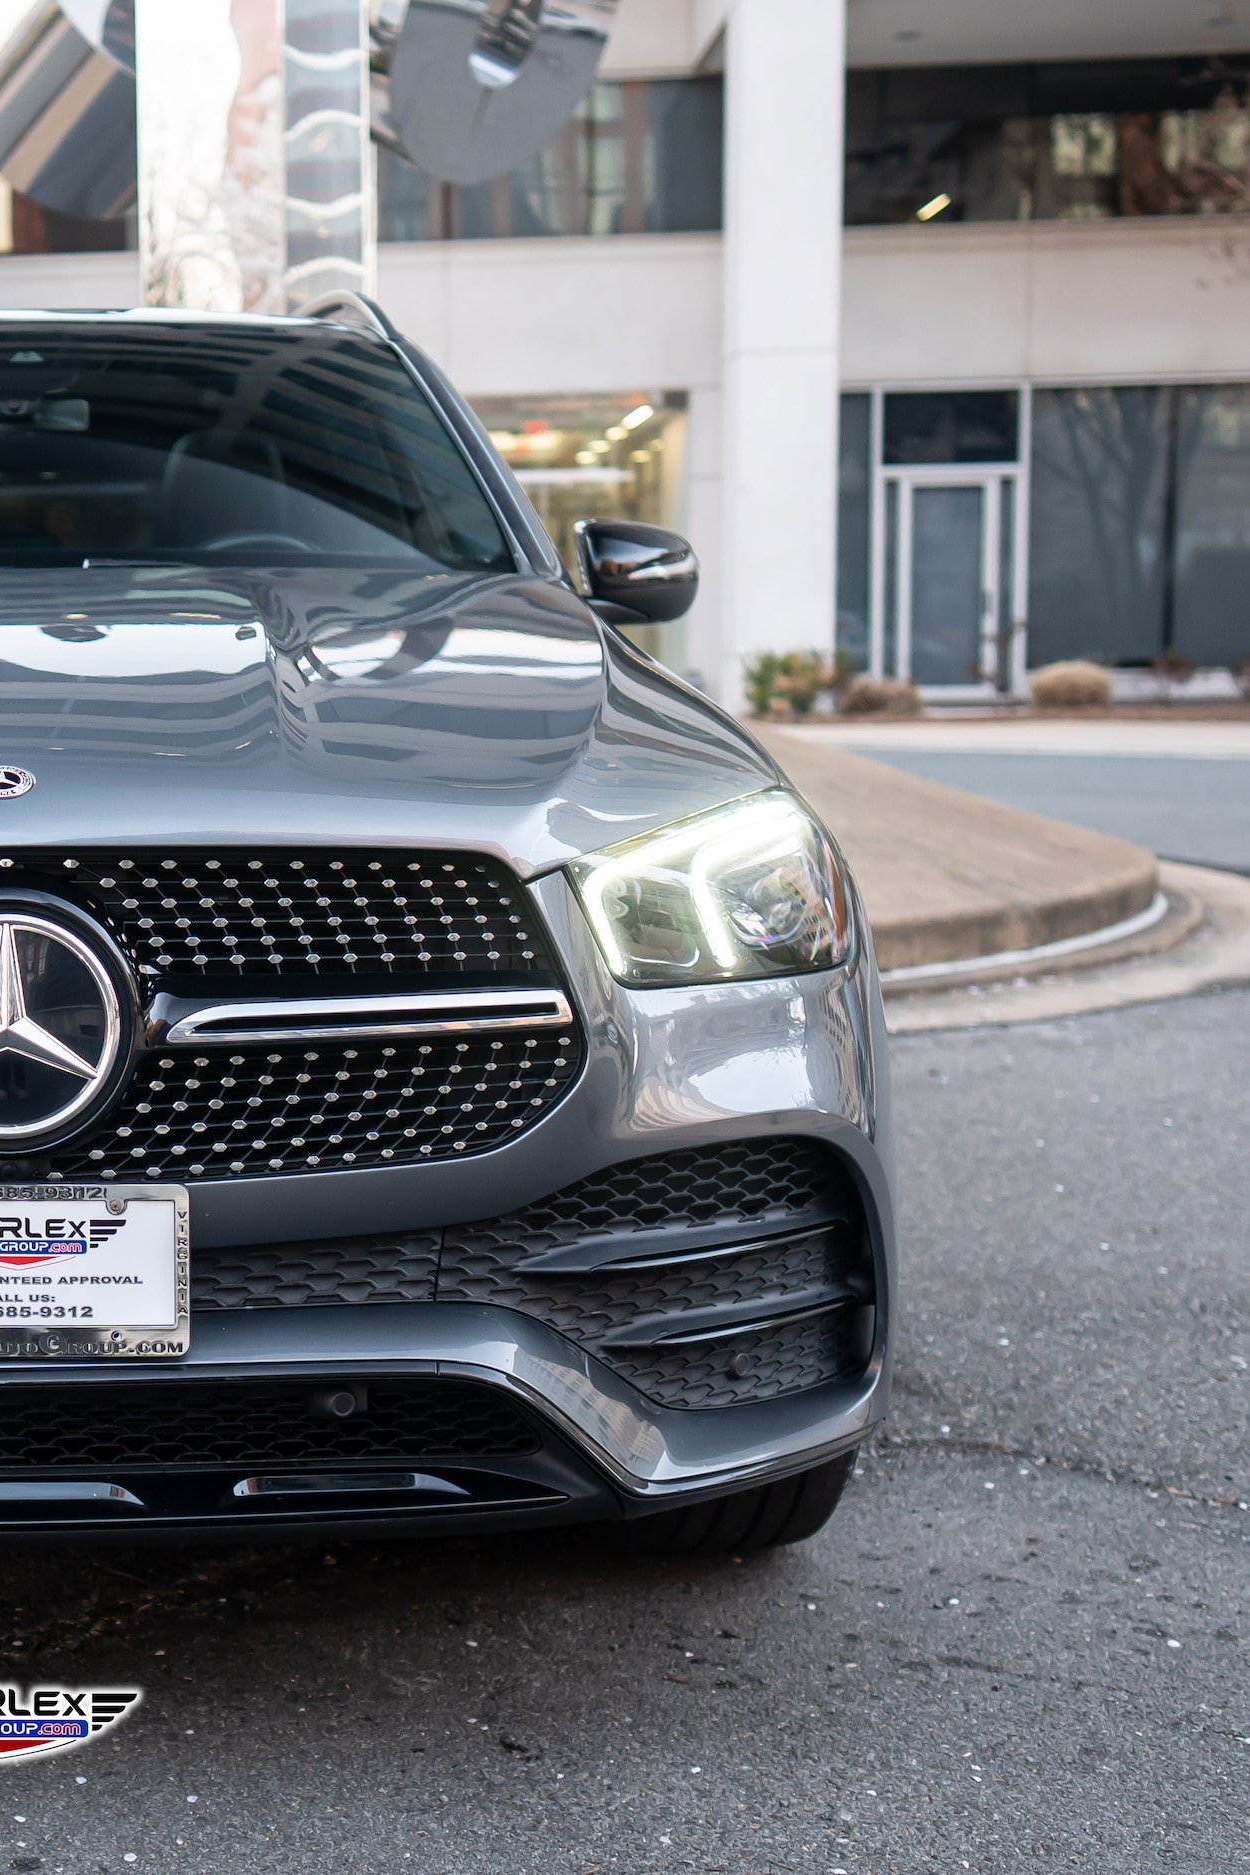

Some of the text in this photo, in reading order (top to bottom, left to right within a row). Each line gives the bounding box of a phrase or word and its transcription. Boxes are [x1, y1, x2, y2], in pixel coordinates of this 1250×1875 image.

[177, 1211, 187, 1315] VIRGINIA
[58, 1275, 143, 1285] APPROVAL
[29, 1293, 56, 1303] US:
